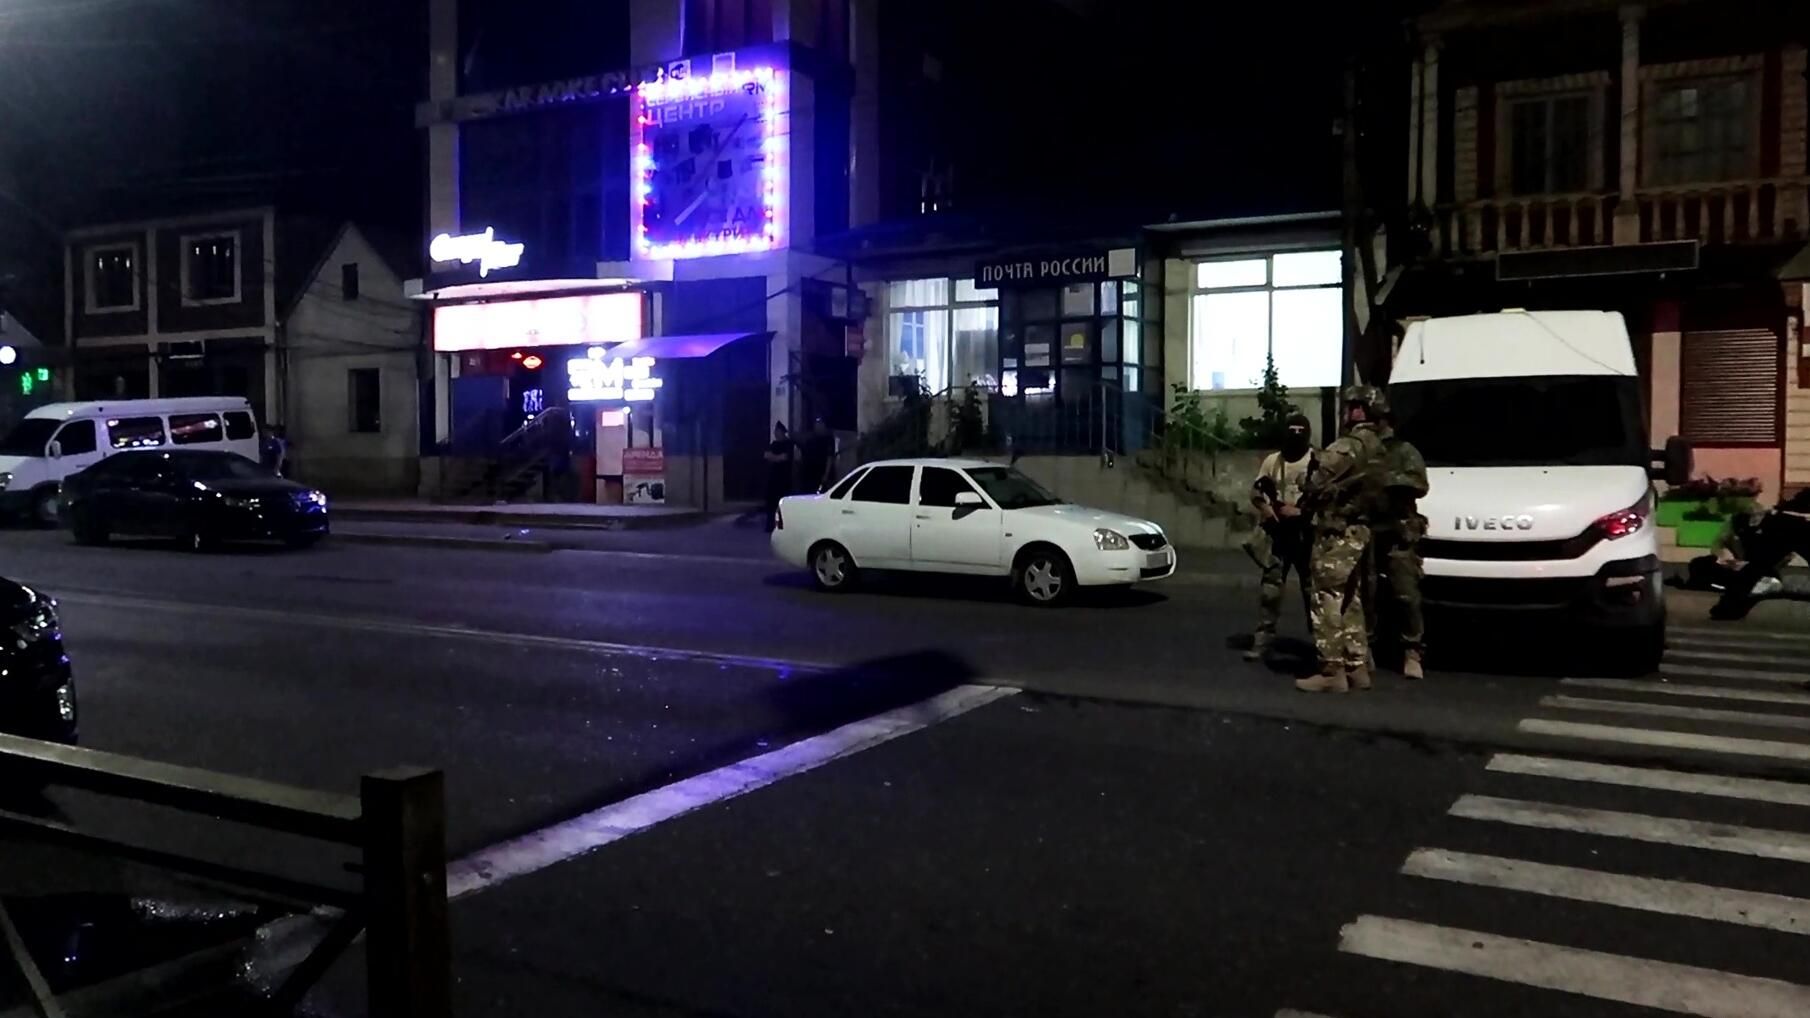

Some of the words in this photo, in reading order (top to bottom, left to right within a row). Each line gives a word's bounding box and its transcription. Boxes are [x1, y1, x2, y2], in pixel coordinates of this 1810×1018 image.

[647, 98, 725, 128] ЦЕНТР
[983, 262, 1033, 282] ПОЧТА
[1041, 256, 1105, 277] РОССИИ
[1454, 515, 1533, 530] IVECO
